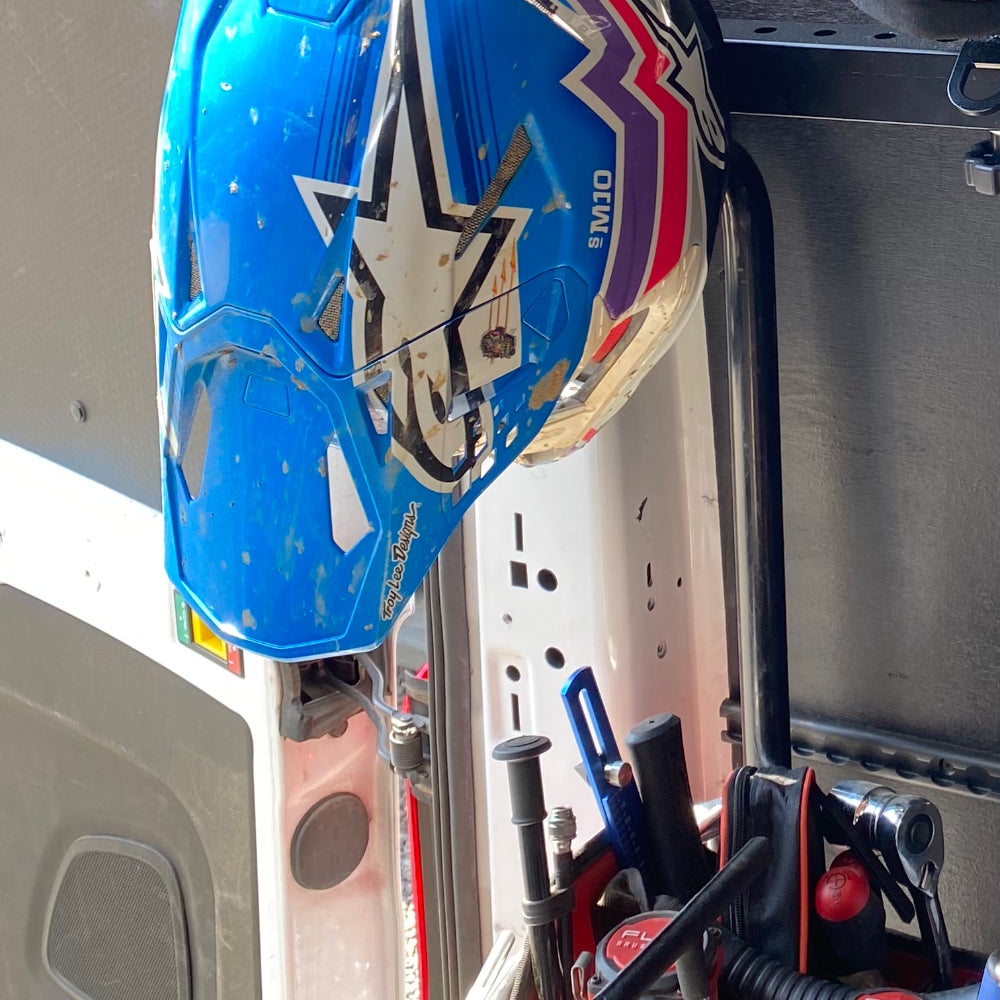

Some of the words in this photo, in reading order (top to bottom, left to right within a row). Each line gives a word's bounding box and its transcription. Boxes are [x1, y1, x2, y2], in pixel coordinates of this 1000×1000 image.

[392, 502, 420, 562] Designs
[388, 562, 404, 591] Lee
[382, 590, 402, 621] Troy
